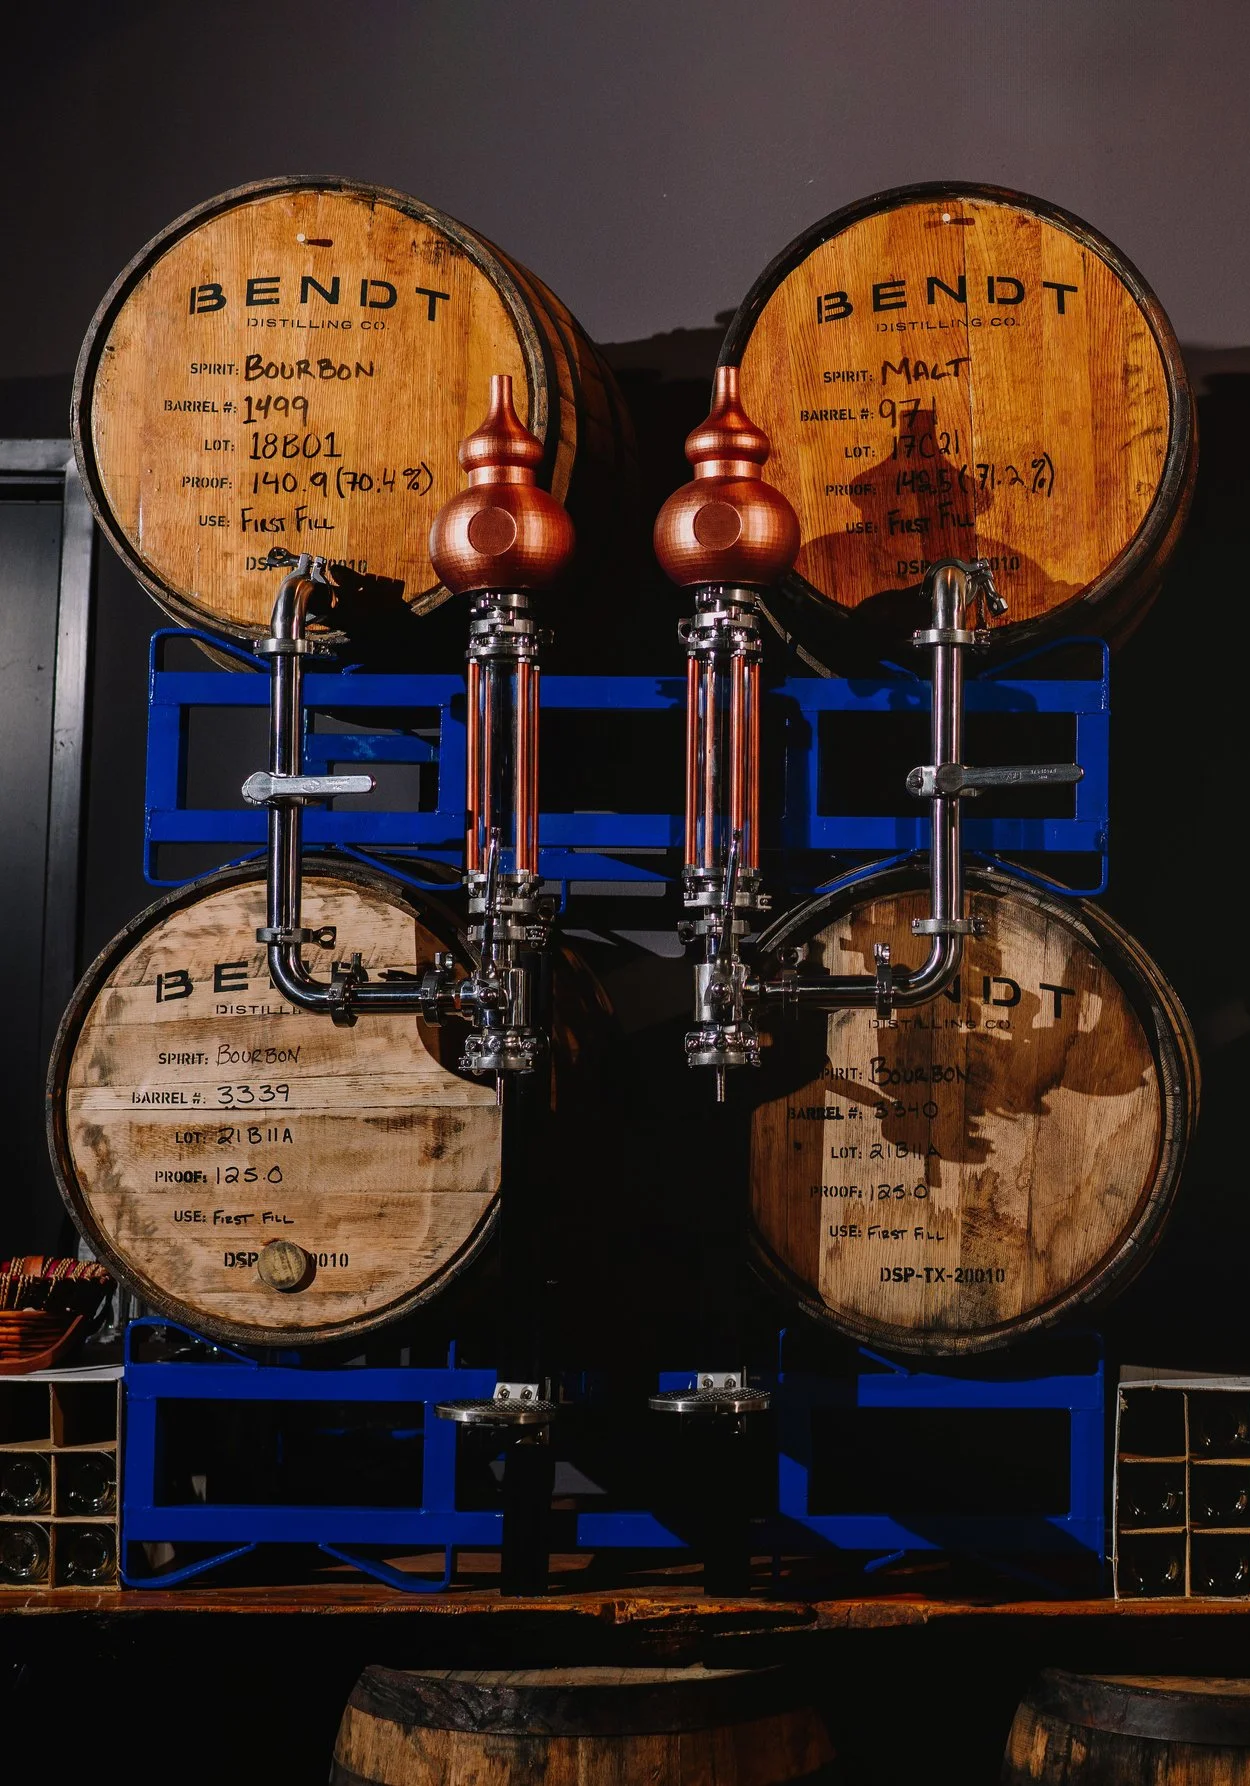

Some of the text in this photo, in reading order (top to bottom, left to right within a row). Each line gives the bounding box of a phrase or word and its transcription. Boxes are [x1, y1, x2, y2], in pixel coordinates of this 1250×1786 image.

[189, 276, 450, 321] BENDT
[817, 275, 1078, 324] BENDT
[247, 318, 353, 330] DISTILLING
[877, 318, 982, 332] DISTILLING
[190, 355, 374, 381] SPIRIT: BOURBON
[823, 357, 969, 384] SPIRIT: MALT
[164, 400, 219, 412] BARREL
[243, 395, 308, 426] 1499
[800, 409, 855, 421] BARREL
[879, 396, 936, 428] 971
[205, 440, 235, 451] LOT:
[845, 430, 959, 460] LOT: 17C21
[182, 477, 232, 489] PROOF:
[826, 485, 876, 496] PROOF:
[199, 516, 230, 527] USE:
[846, 522, 877, 534] USE:
[868, 1019, 976, 1030] DISTILLING
[158, 1045, 300, 1066] SPIRIT: BOURBON
[868, 1056, 970, 1087] BOURBON
[132, 1092, 190, 1104] BARREL
[217, 1085, 289, 1104] 3339
[787, 1107, 844, 1120] BARREL
[873, 1101, 937, 1119] 3340
[175, 1131, 207, 1144] LOT:
[831, 1146, 861, 1159] LOT:
[155, 1166, 283, 1184] PROOF: 125.0
[810, 1185, 861, 1199] PROOF:
[174, 1211, 206, 1223] USE:
[829, 1225, 861, 1237] USE:
[880, 1267, 1005, 1283] DSP-TX-20010
